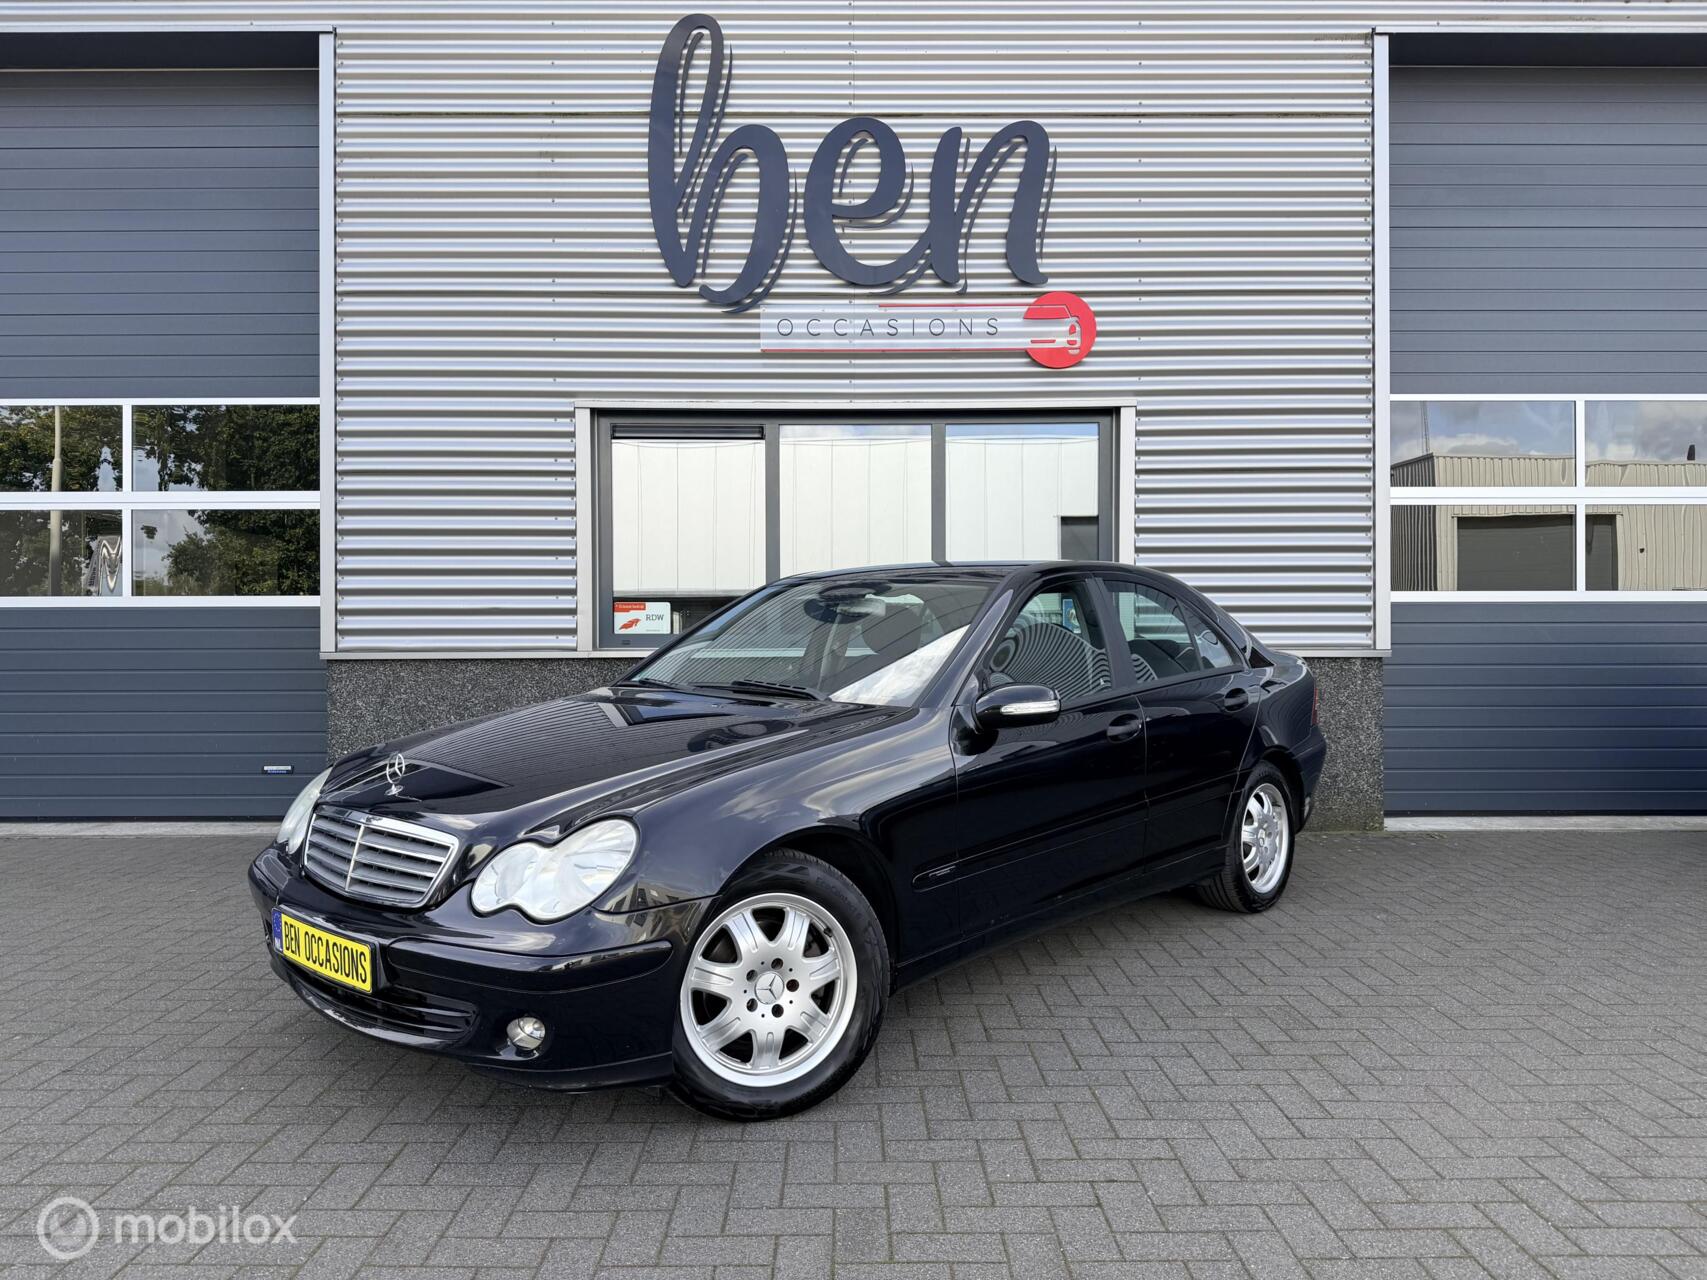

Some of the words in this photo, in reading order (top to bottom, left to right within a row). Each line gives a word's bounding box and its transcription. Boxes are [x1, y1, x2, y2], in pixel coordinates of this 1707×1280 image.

[648, 13, 1055, 312] ben
[777, 317, 998, 337] OCCASIONS
[284, 921, 301, 957] BEN
[304, 931, 367, 984] OCCASIONS
